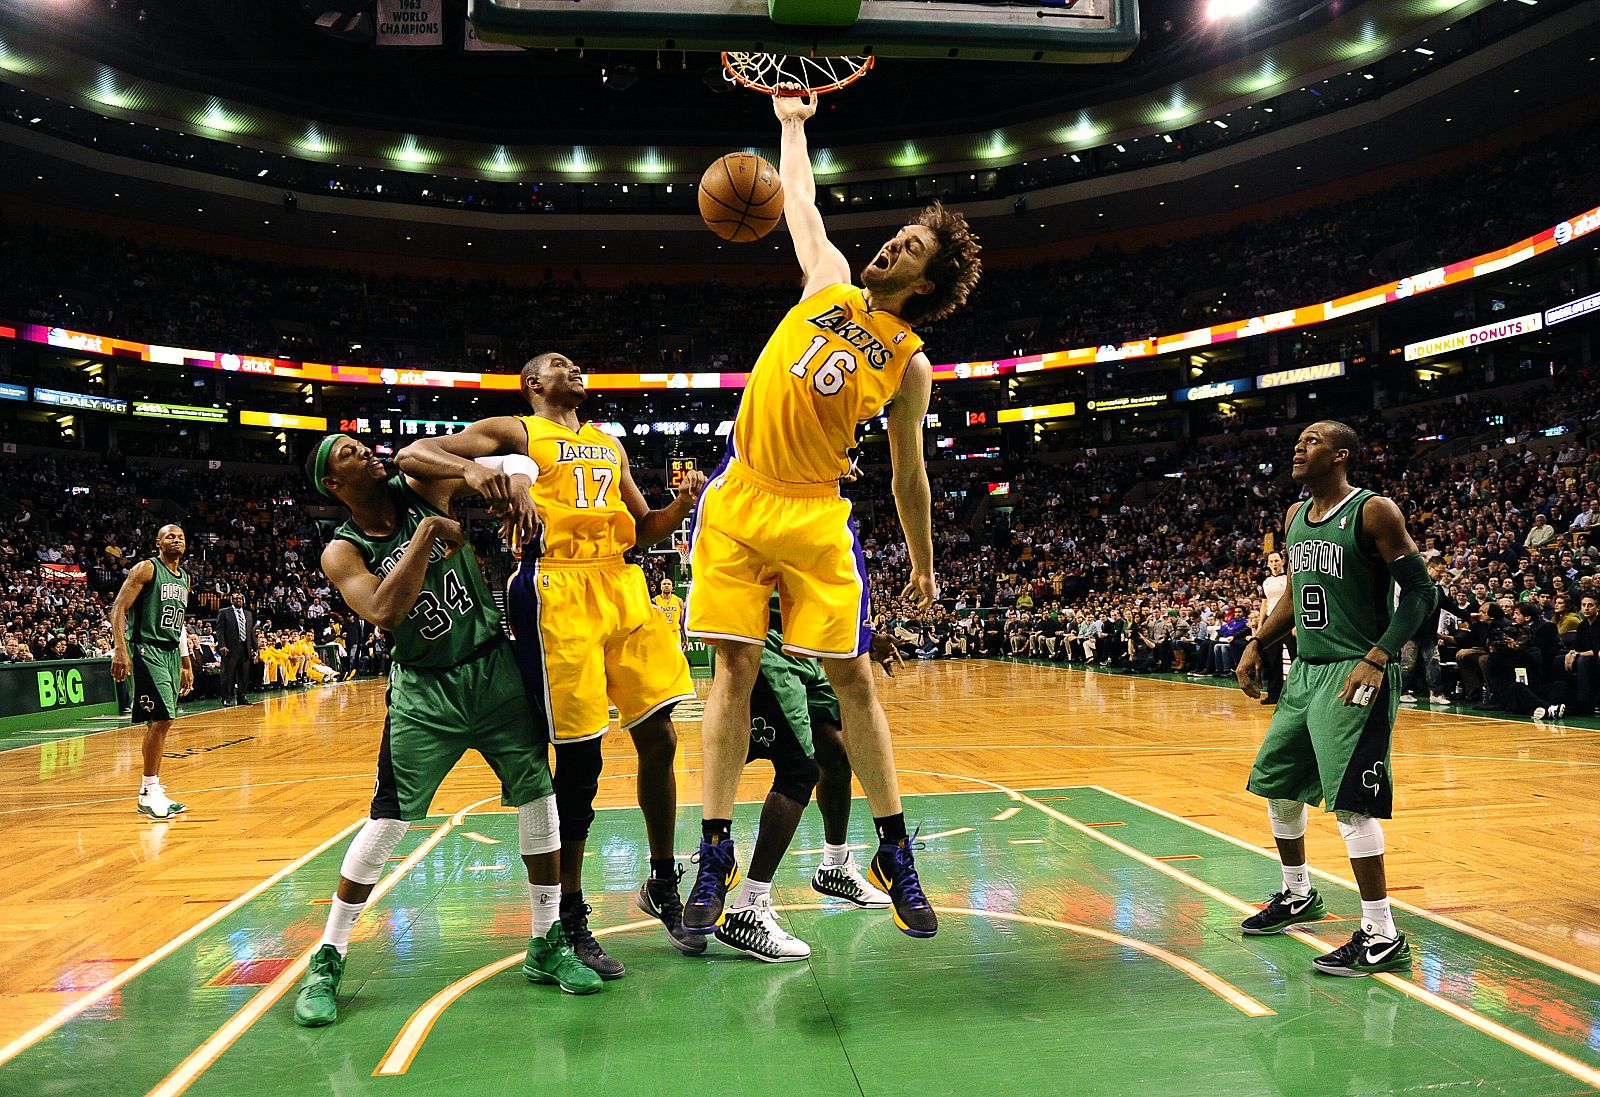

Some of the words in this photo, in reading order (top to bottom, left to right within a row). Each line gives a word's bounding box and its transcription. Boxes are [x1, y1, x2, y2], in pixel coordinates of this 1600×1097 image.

[393, 12, 428, 22] WORLD
[380, 23, 438, 34] CHAMPIONS
[806, 305, 893, 370] LAKERS
[1417, 335, 1469, 357] DUNKIN'
[1470, 322, 1523, 344] DONUTS
[790, 335, 857, 396] 16
[1260, 362, 1341, 388] SYLVANIA
[1187, 383, 1235, 400] Gillette
[59, 395, 100, 409] DAILY
[101, 400, 115, 412] 10p
[116, 403, 127, 412] ET
[340, 419, 357, 432] 24
[969, 412, 986, 424] 24
[633, 423, 650, 435] 49
[694, 423, 710, 435] 45
[556, 441, 618, 465] LAKERS
[573, 466, 613, 508] 17
[408, 568, 473, 640] 34
[1301, 584, 1328, 629] 9
[161, 605, 184, 631] 20
[666, 613, 673, 624] 2
[1366, 924, 1372, 932] 9
